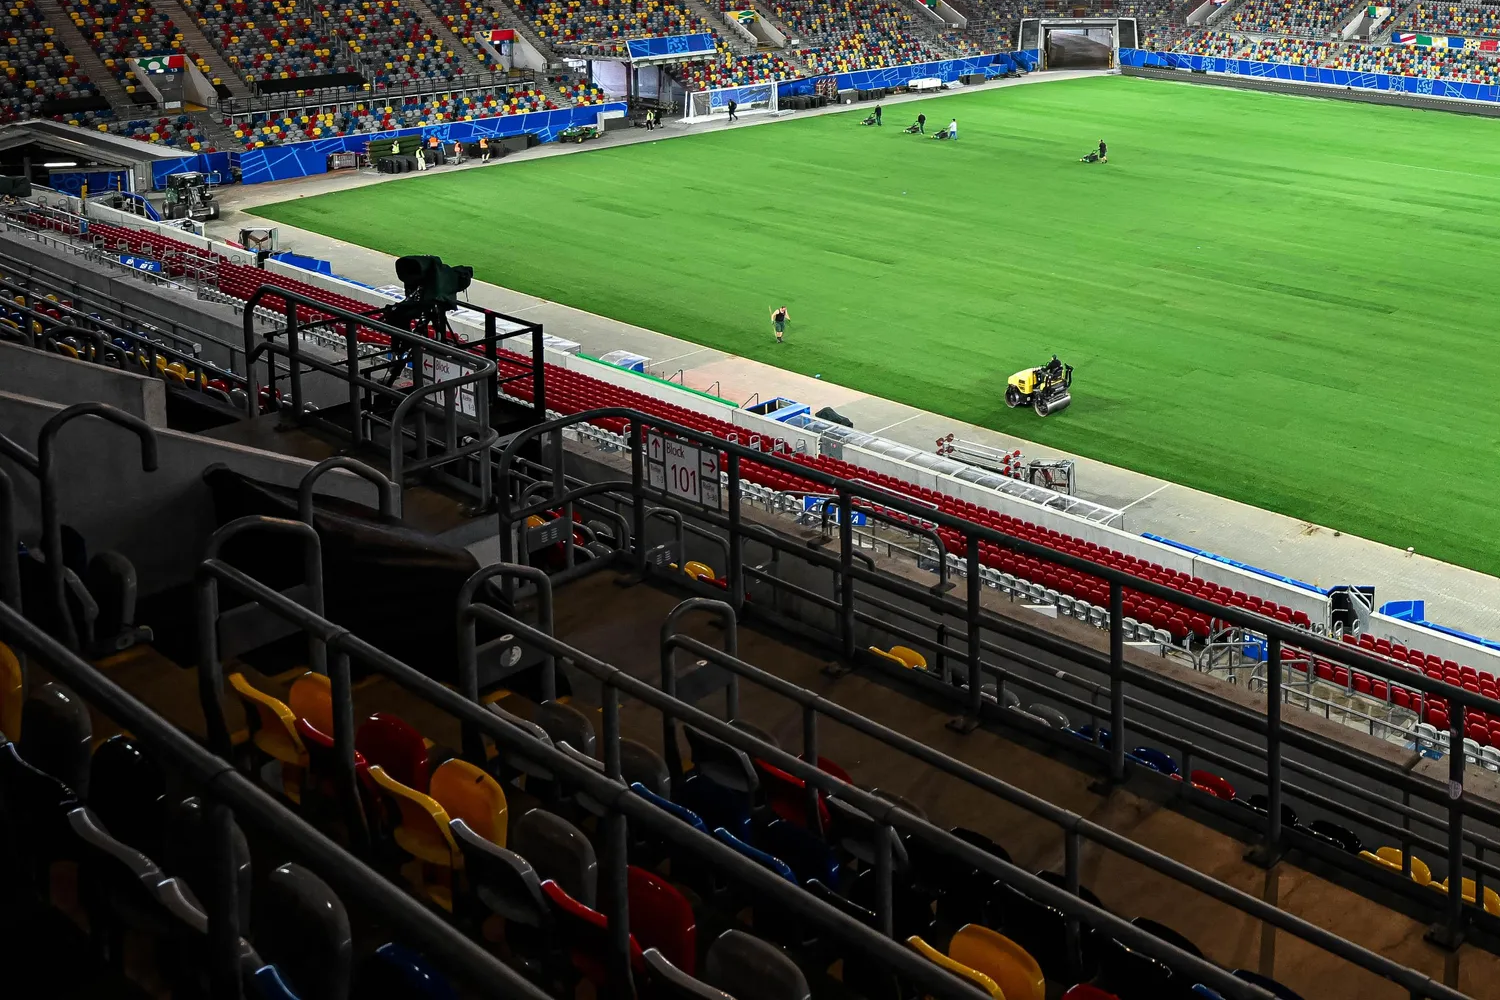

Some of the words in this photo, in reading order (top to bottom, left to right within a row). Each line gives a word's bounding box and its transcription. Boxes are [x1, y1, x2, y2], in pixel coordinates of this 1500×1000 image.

[435, 360, 450, 375] Block
[666, 442, 686, 458] Block
[671, 463, 697, 496] 101
